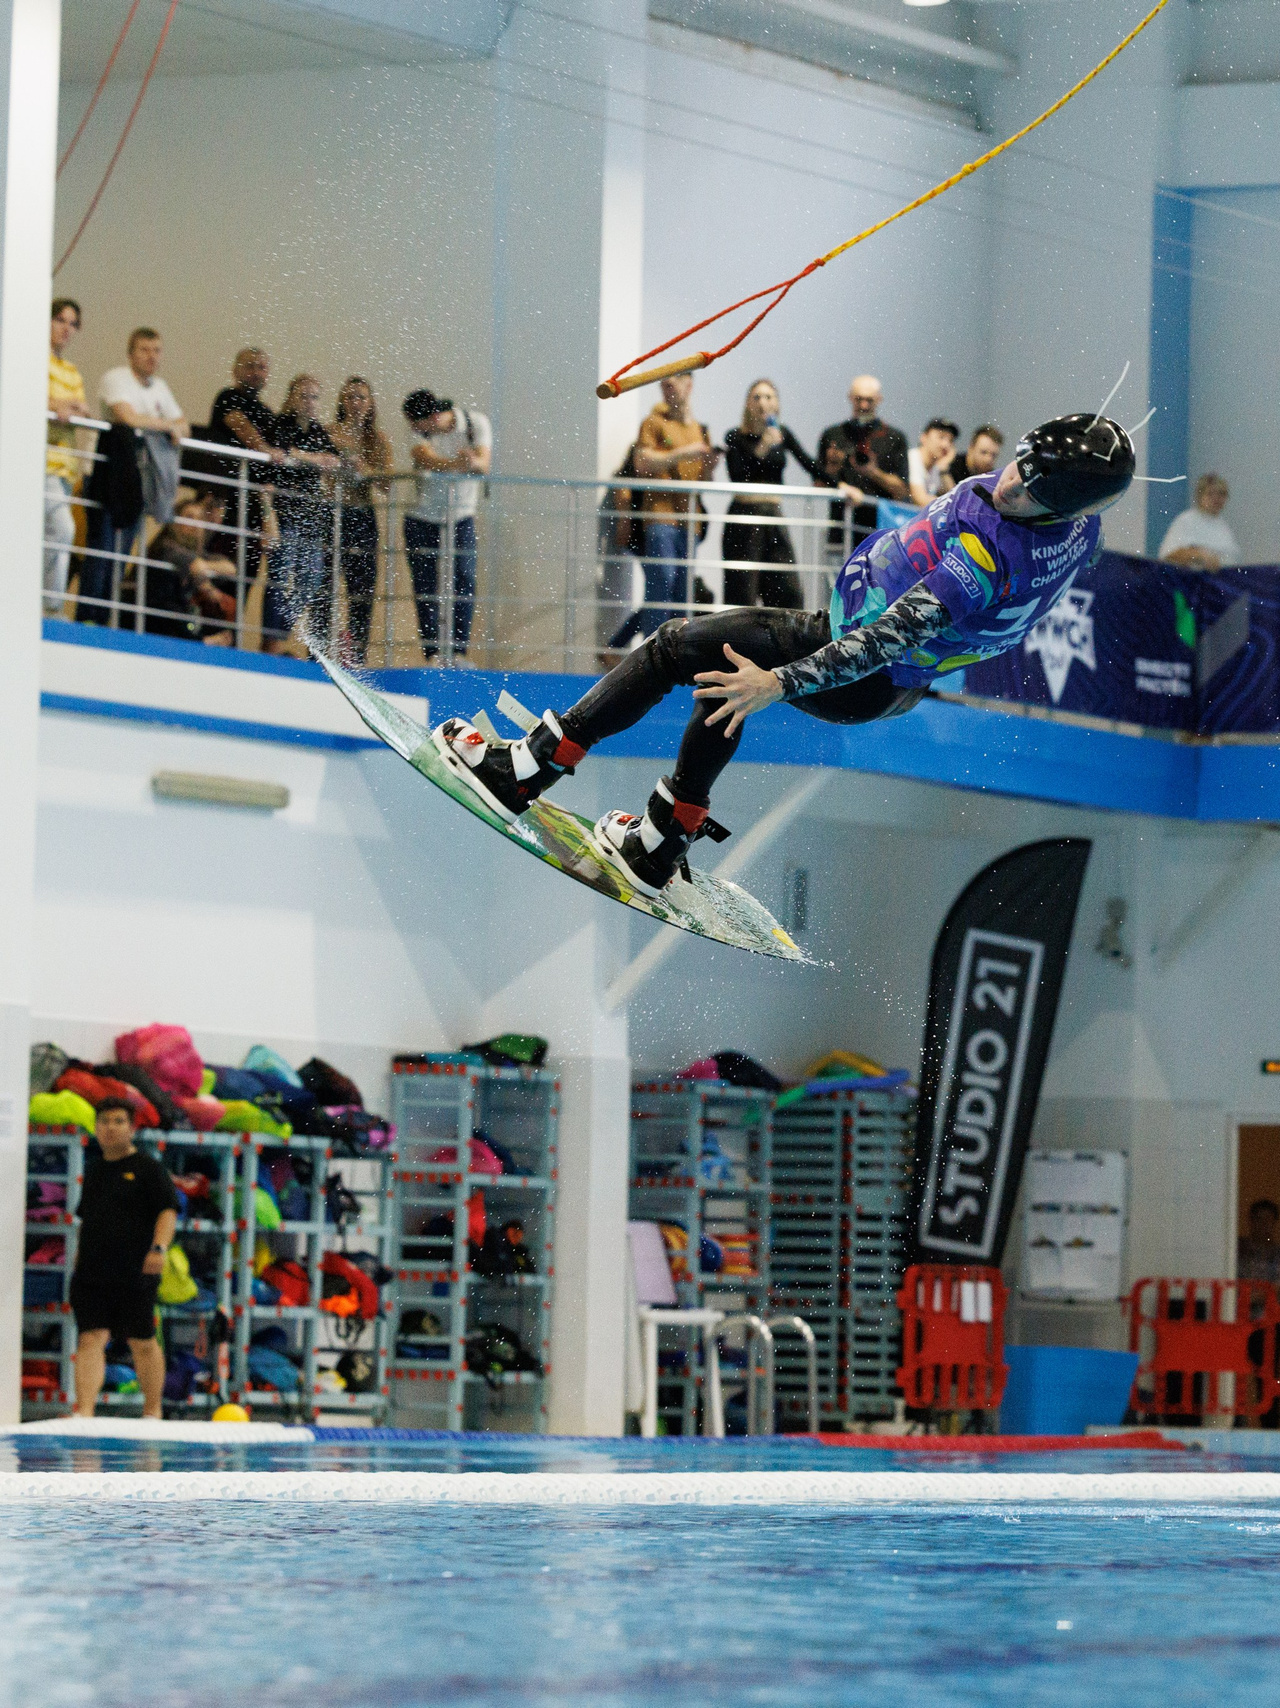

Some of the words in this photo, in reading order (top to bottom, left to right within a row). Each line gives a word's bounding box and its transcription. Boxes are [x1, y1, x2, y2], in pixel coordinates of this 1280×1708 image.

[946, 556, 971, 583] STUDIO
[969, 583, 979, 594] 21
[971, 956, 1022, 1019] 21
[938, 1028, 1008, 1225] STUDIO
